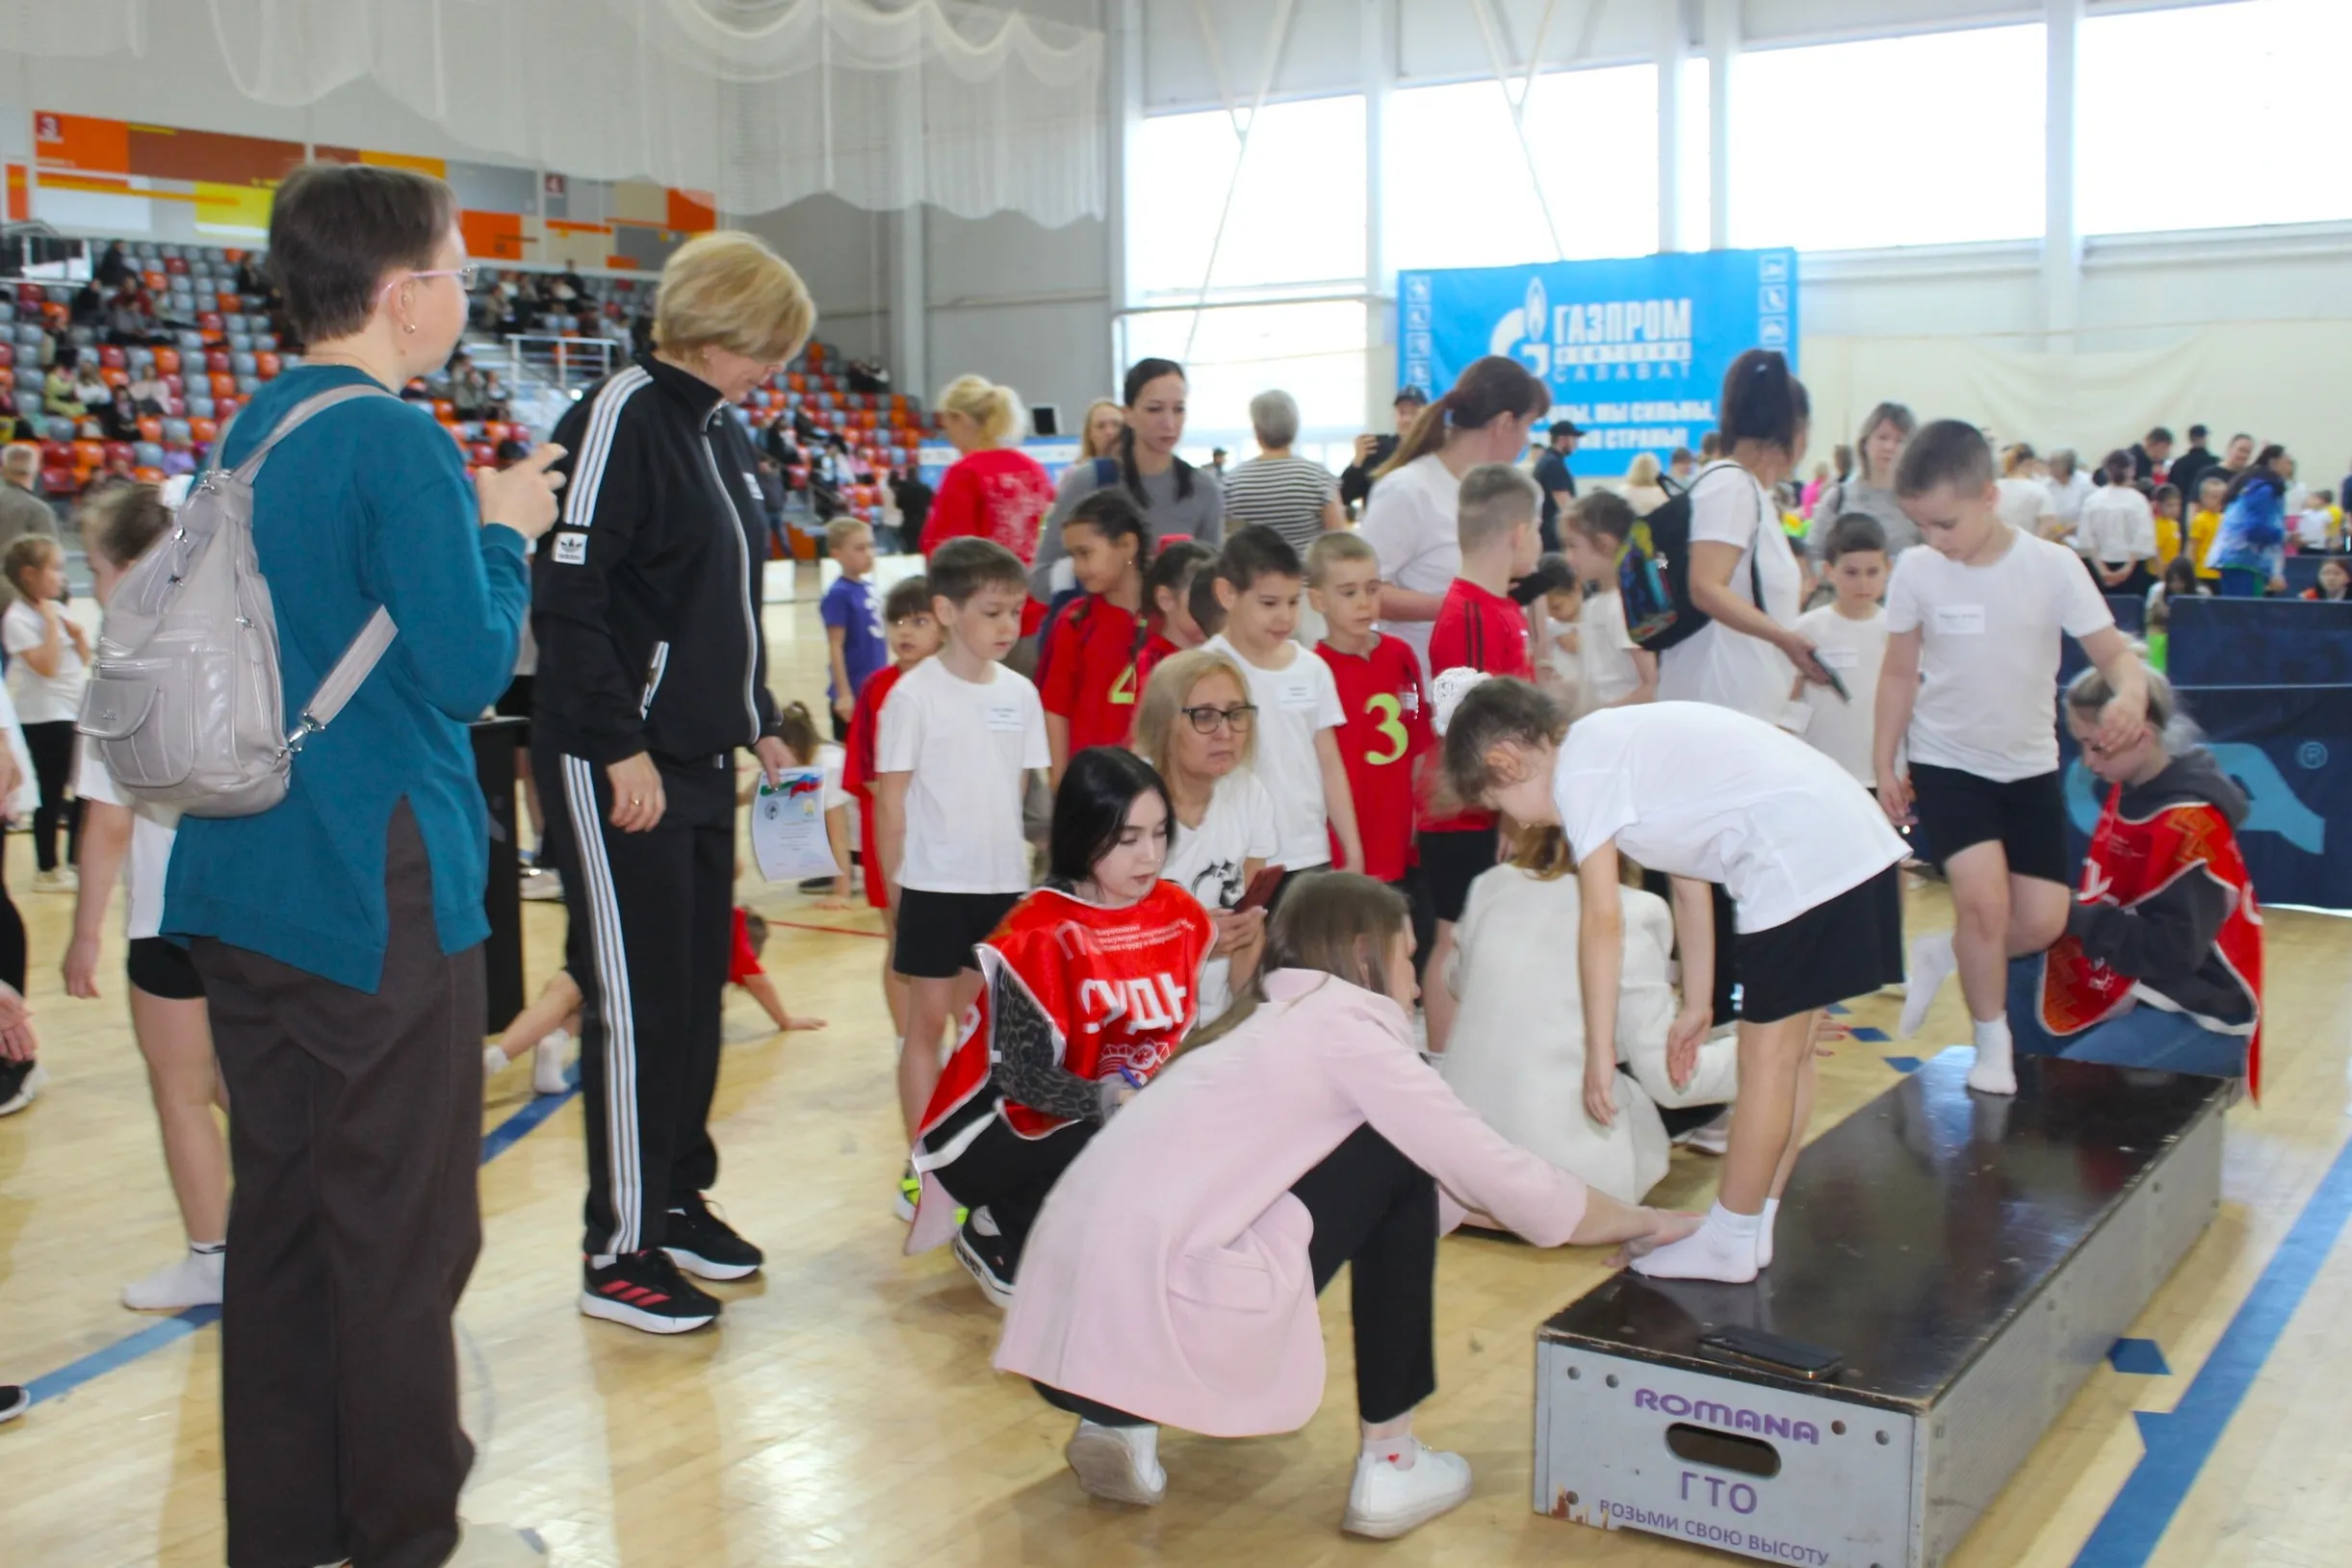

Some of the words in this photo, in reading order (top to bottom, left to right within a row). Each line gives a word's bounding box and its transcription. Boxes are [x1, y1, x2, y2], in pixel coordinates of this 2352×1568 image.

[1554, 298, 1692, 344] ГАЗПРОМ
[1553, 361, 1692, 382] САЛАВАТ
[1363, 693, 1409, 765] 3
[1635, 1388, 1820, 1445] ROMANA
[1680, 1471, 1757, 1514] ГТО
[1600, 1499, 1678, 1530] ВОЗЬМИ
[1685, 1520, 1743, 1546] СВОЮ
[1748, 1534, 1830, 1566] ВЫСОТУ
